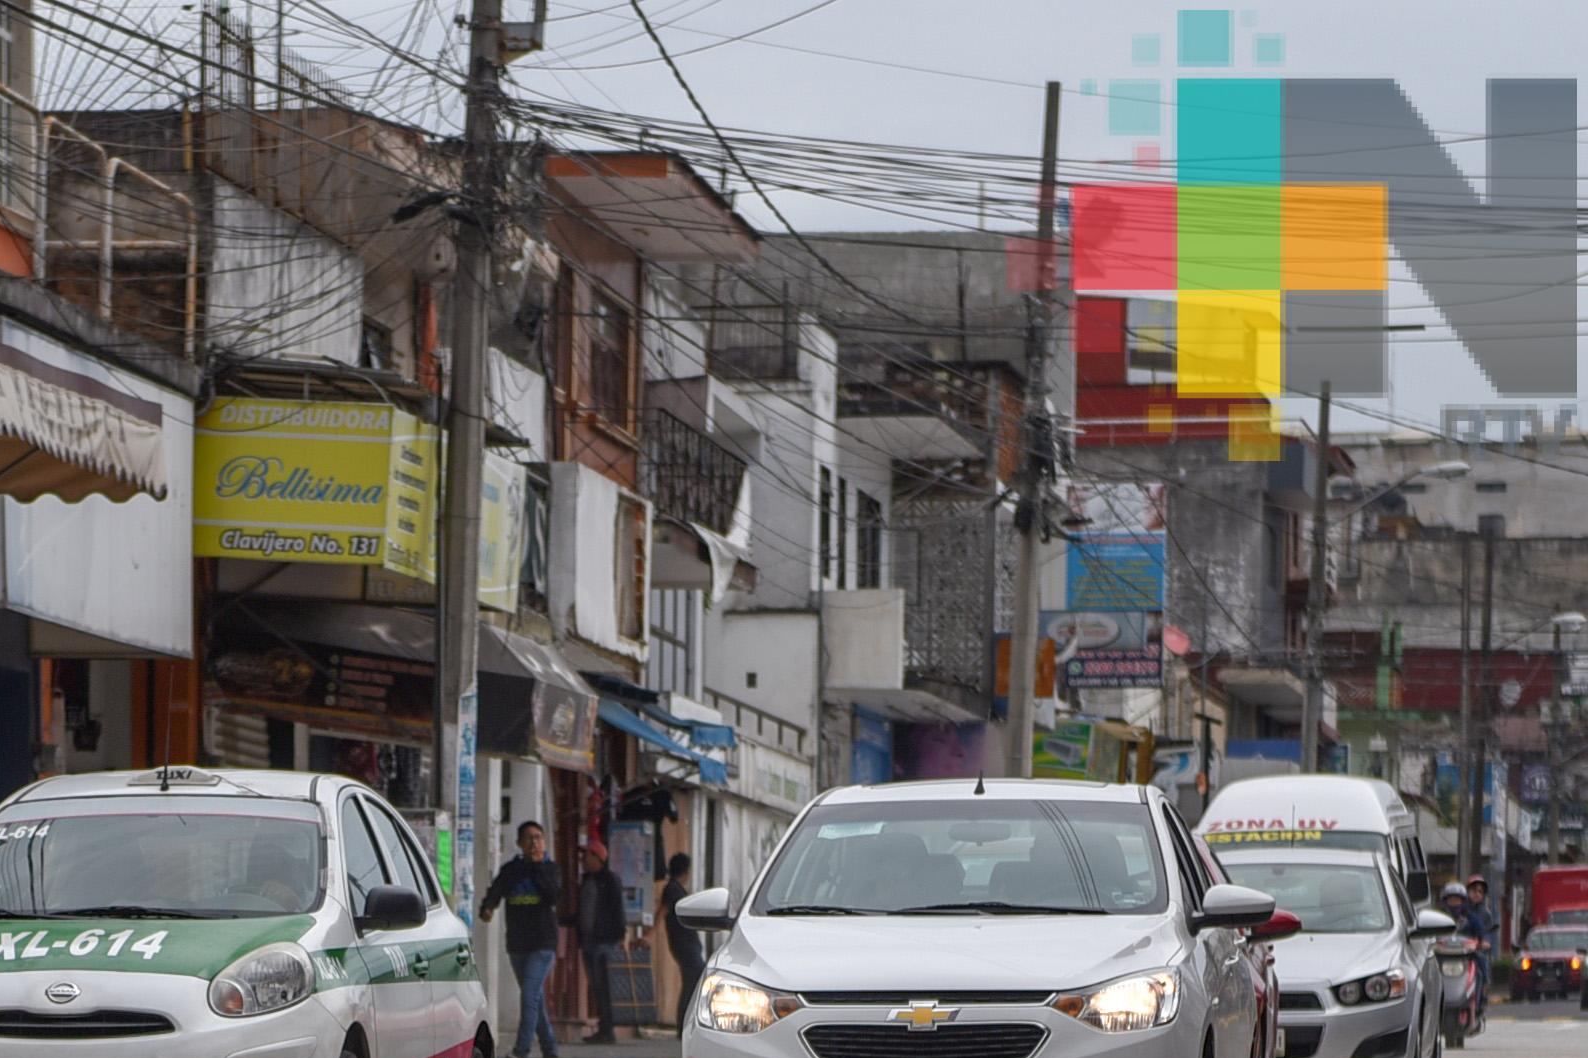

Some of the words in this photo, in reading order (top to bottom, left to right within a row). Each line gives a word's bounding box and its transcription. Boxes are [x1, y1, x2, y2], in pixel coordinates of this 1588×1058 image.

[220, 404, 390, 431] DISTRIBUIDORA
[215, 454, 384, 505] Bellisima
[220, 528, 306, 556] Clavijero
[310, 534, 344, 555] No.
[348, 534, 379, 555] 131
[1207, 819, 1286, 833] ZONA
[1298, 819, 1339, 831] UV
